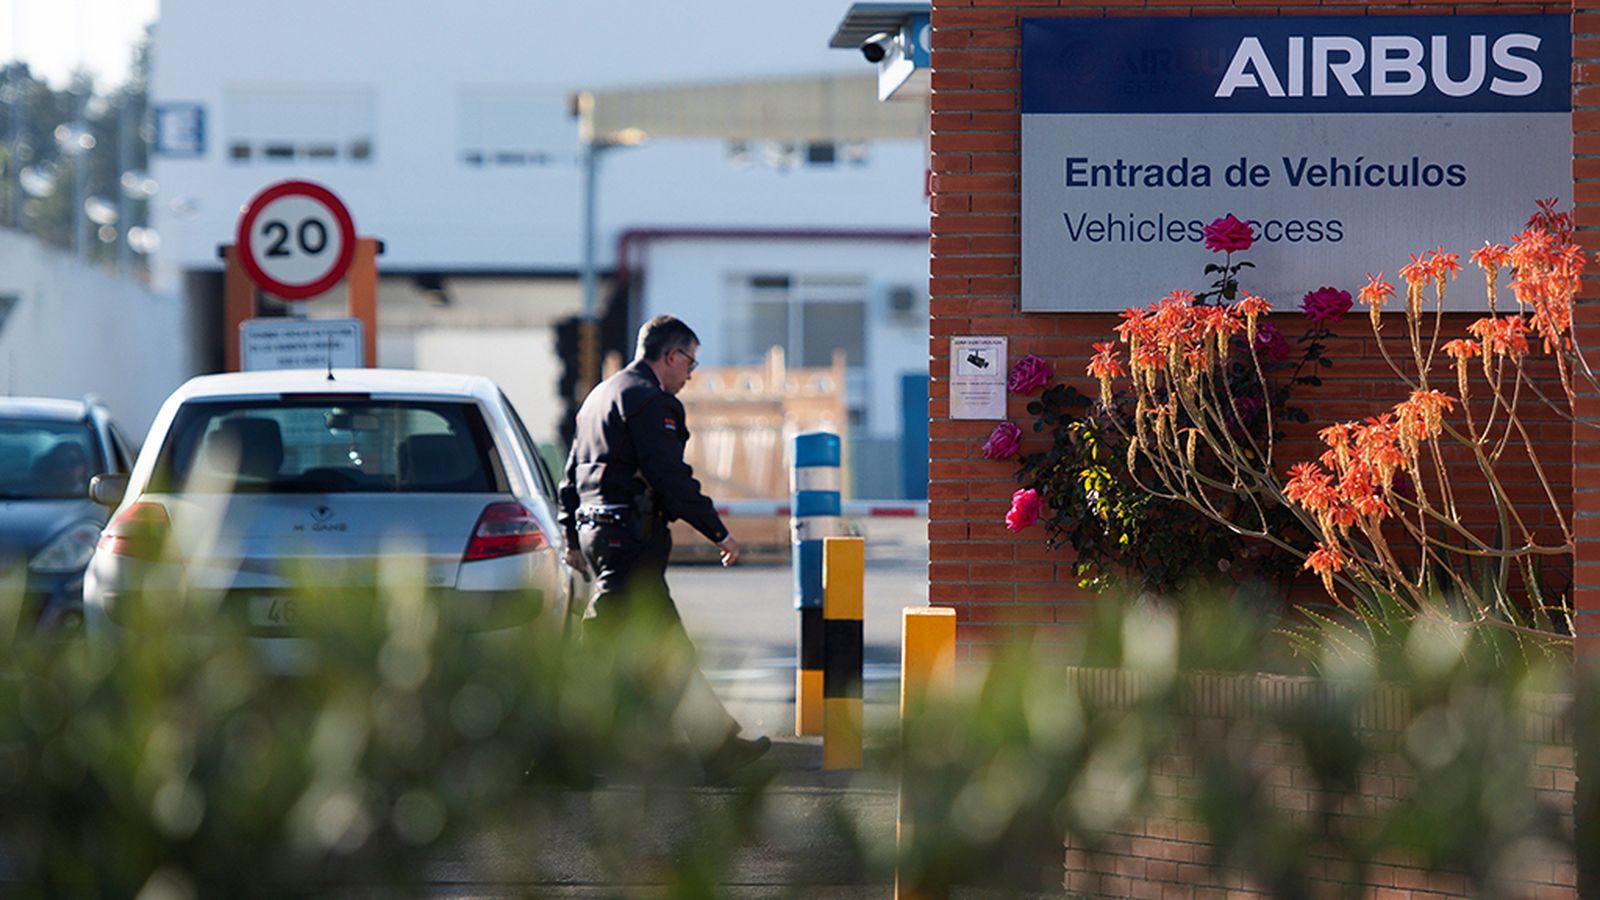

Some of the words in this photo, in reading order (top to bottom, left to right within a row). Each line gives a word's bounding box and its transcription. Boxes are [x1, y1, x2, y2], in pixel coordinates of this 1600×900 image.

[1215, 34, 1542, 97] AIRBUS
[1066, 158, 1210, 187] Entrada
[1225, 157, 1270, 187] de
[1283, 157, 1466, 187] Vehículos
[261, 218, 328, 257] 20
[1064, 213, 1204, 242] Vehicles
[1216, 213, 1343, 242] ccess
